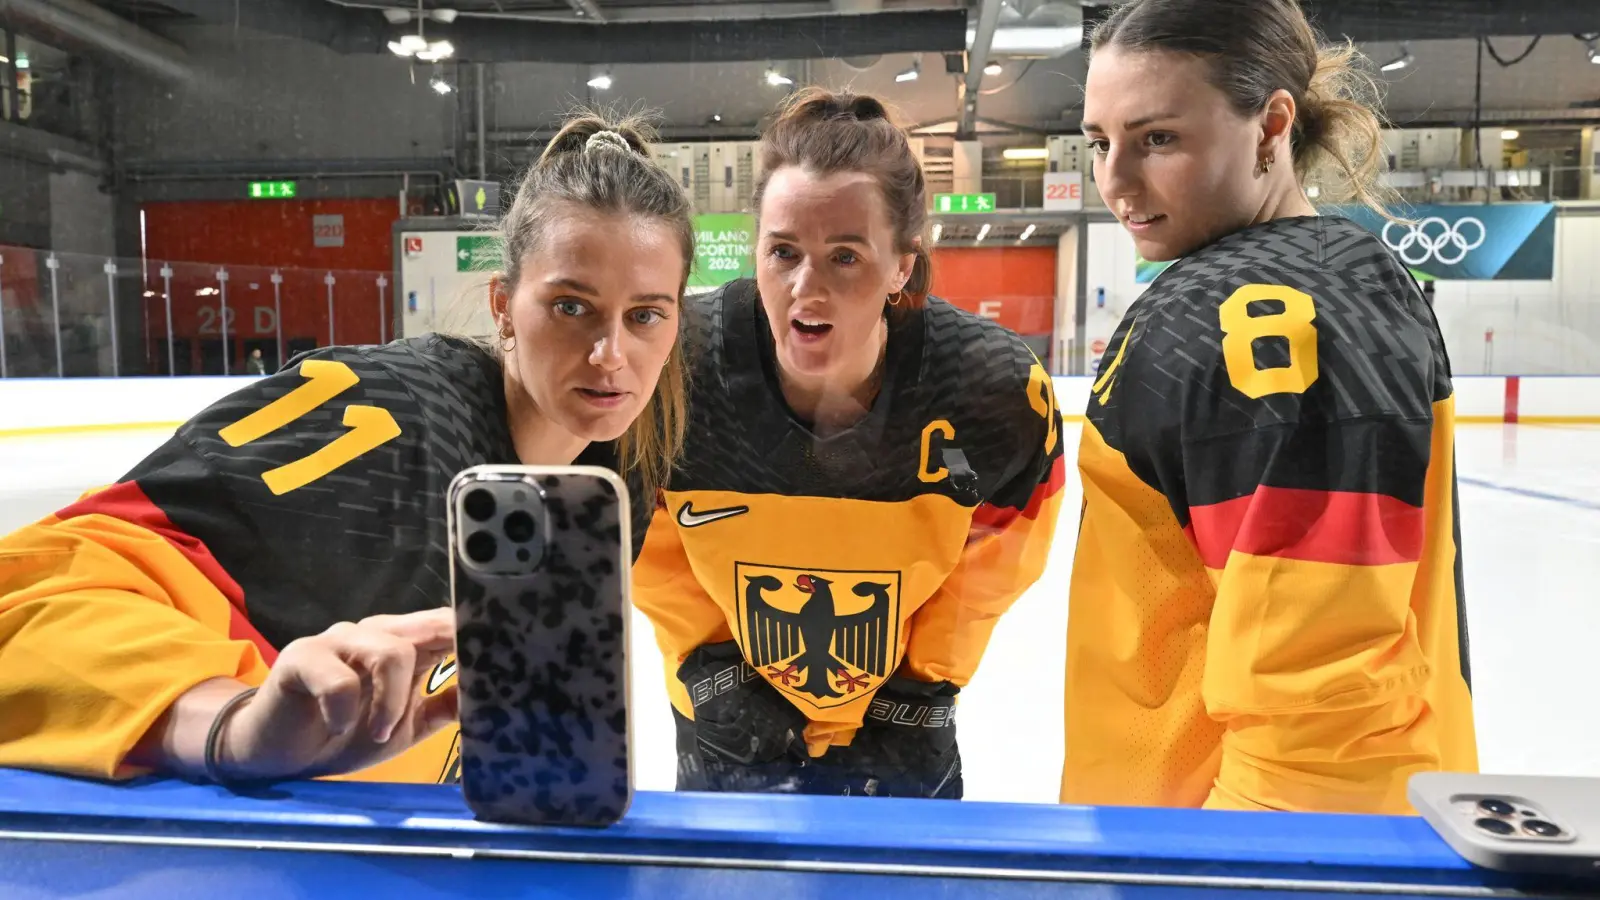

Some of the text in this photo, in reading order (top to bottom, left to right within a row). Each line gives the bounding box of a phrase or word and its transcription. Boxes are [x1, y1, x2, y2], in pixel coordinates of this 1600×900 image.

[1046, 183, 1081, 200] 22E
[693, 230, 749, 243] MILANO
[696, 243, 753, 257] CORTIN
[708, 257, 740, 271] 2026
[197, 306, 278, 334] 22 D
[1219, 283, 1319, 400] 8
[218, 359, 402, 496] 11
[917, 419, 956, 483] C
